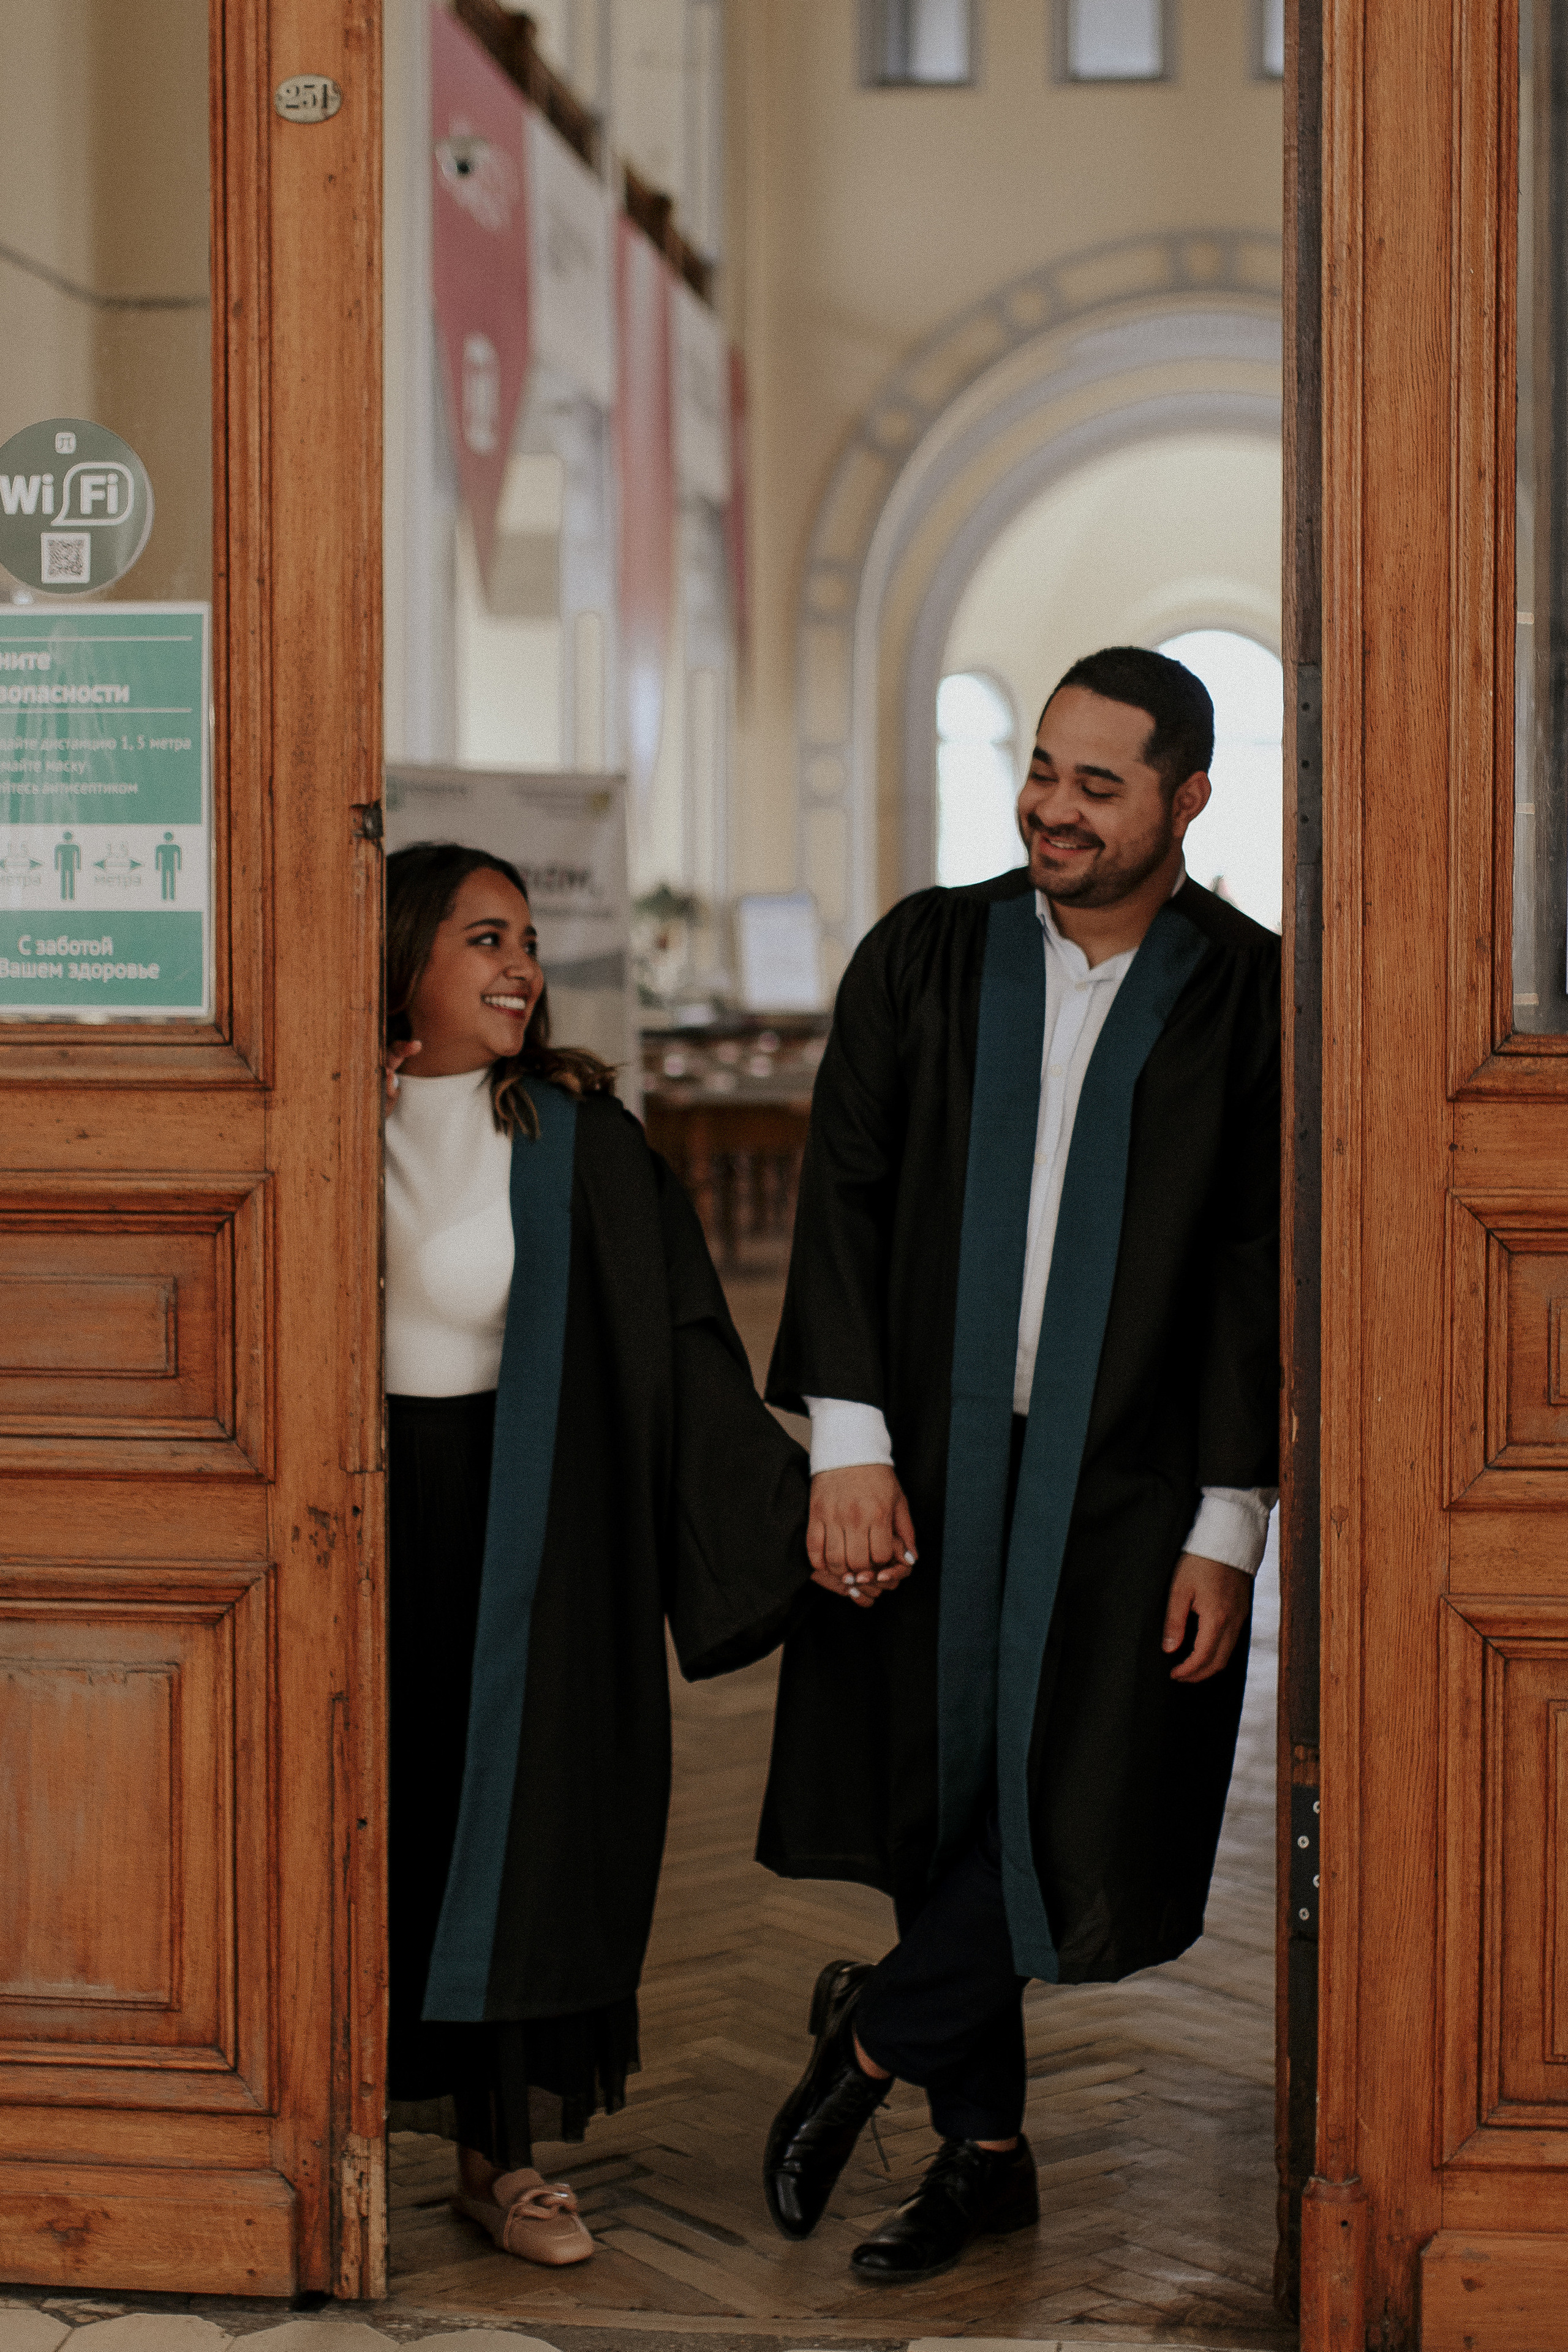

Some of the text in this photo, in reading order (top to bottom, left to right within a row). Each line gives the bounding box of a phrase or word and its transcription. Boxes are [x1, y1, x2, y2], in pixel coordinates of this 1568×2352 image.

[285, 83, 328, 109] 251
[40, 737, 116, 752] дистанцию
[149, 737, 192, 752] метра
[45, 760, 86, 774] маску
[42, 782, 138, 794] антисептиком
[18, 935, 114, 956] С заботой
[68, 962, 160, 983] здоровье
